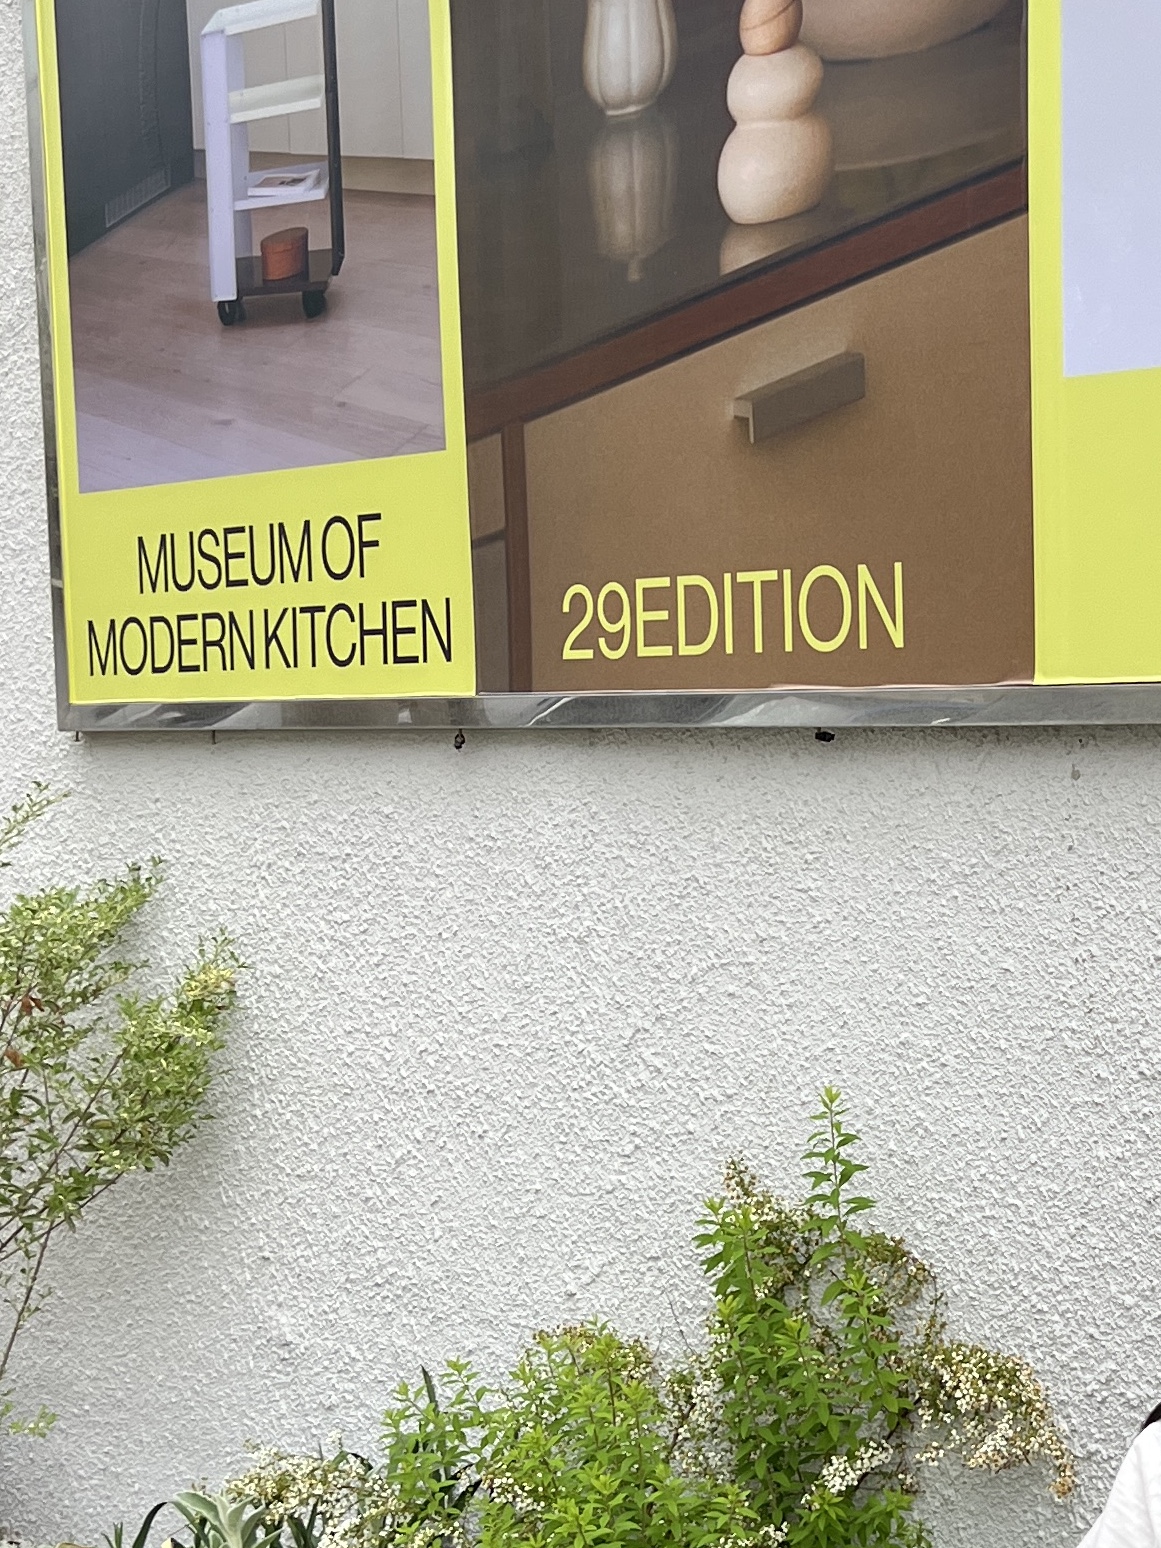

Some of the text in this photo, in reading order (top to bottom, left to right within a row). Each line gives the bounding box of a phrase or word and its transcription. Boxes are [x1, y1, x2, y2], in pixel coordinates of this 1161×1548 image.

[137, 512, 382, 594] MUSEUM OF
[87, 597, 453, 676] MODERN KITCHEN
[562, 561, 905, 660] 29EDITION
